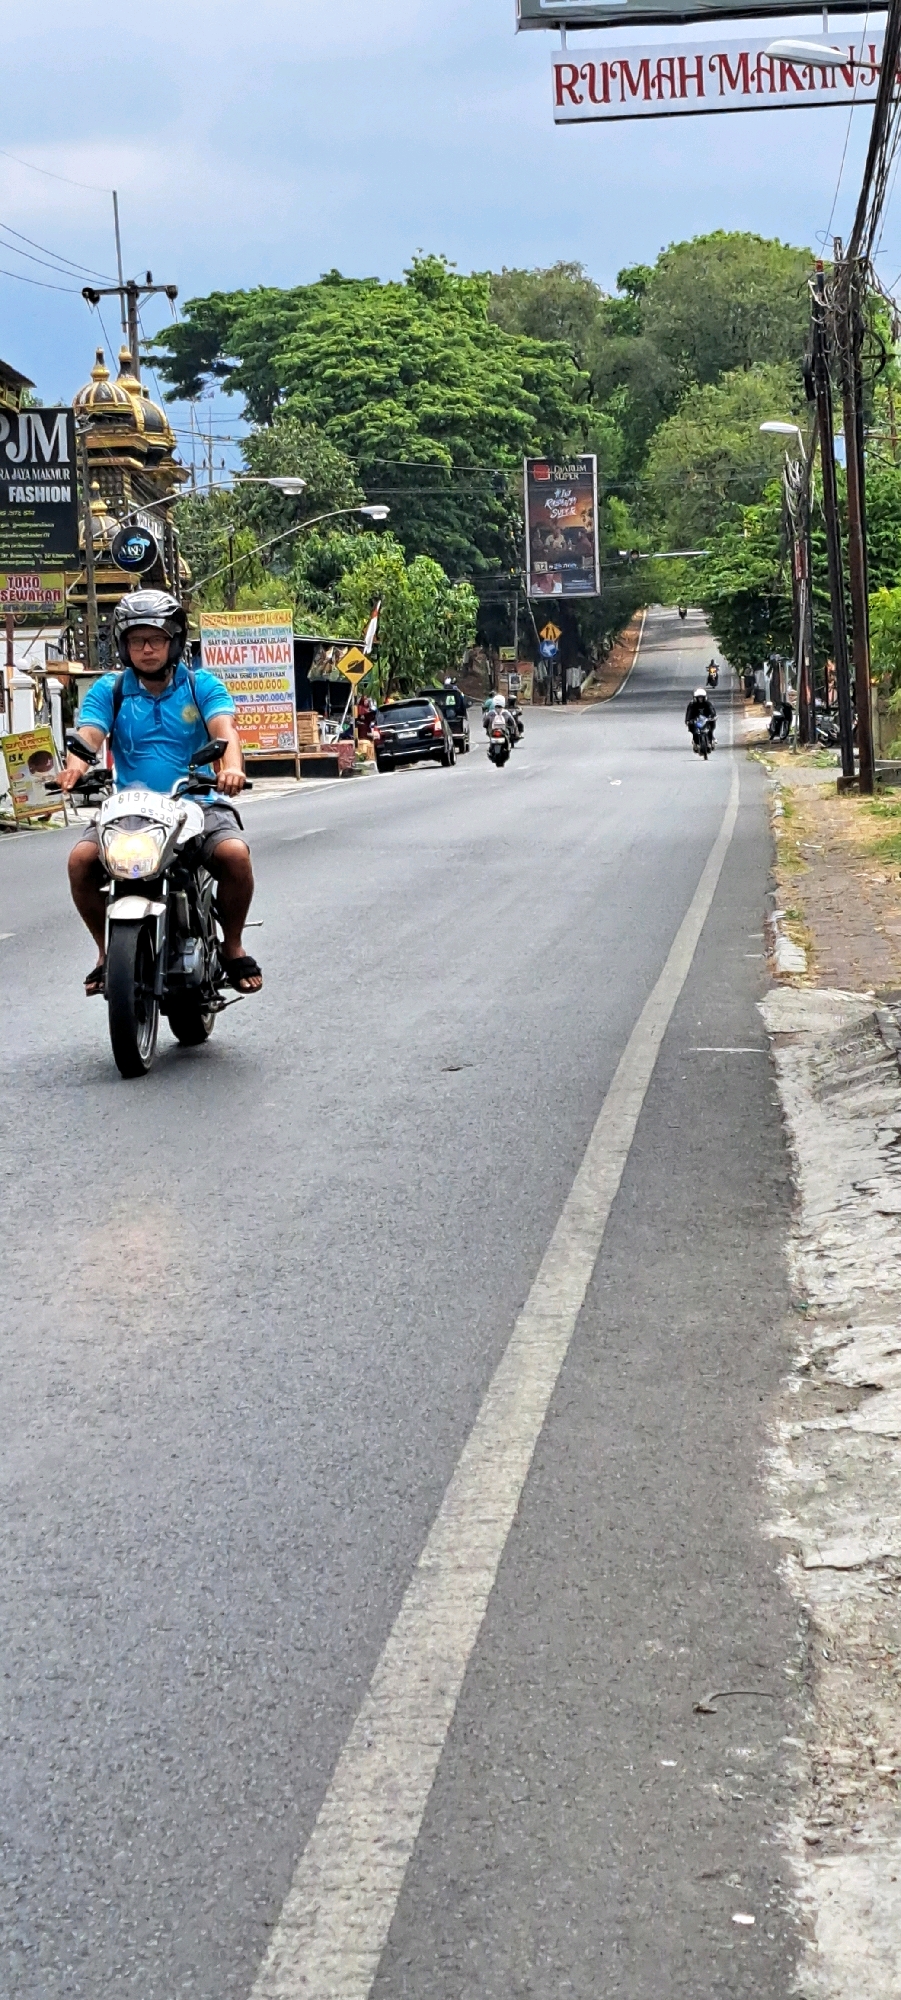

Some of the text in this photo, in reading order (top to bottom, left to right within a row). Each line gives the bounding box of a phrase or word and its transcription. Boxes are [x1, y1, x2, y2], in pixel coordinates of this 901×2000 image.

[554, 55, 705, 107] RUMAH
[709, 45, 855, 96] MAKAN
[12, 468, 31, 480] JAYA
[32, 468, 71, 480] MAKMUR
[554, 473, 579, 481] SUPER
[9, 486, 71, 503] FASHION
[8, 576, 40, 589] TOKO
[204, 644, 292, 666] WAKAF TANAH
[264, 712, 293, 724] 7223
[103, 800, 110, 812] N
[117, 791, 149, 804] 6197
